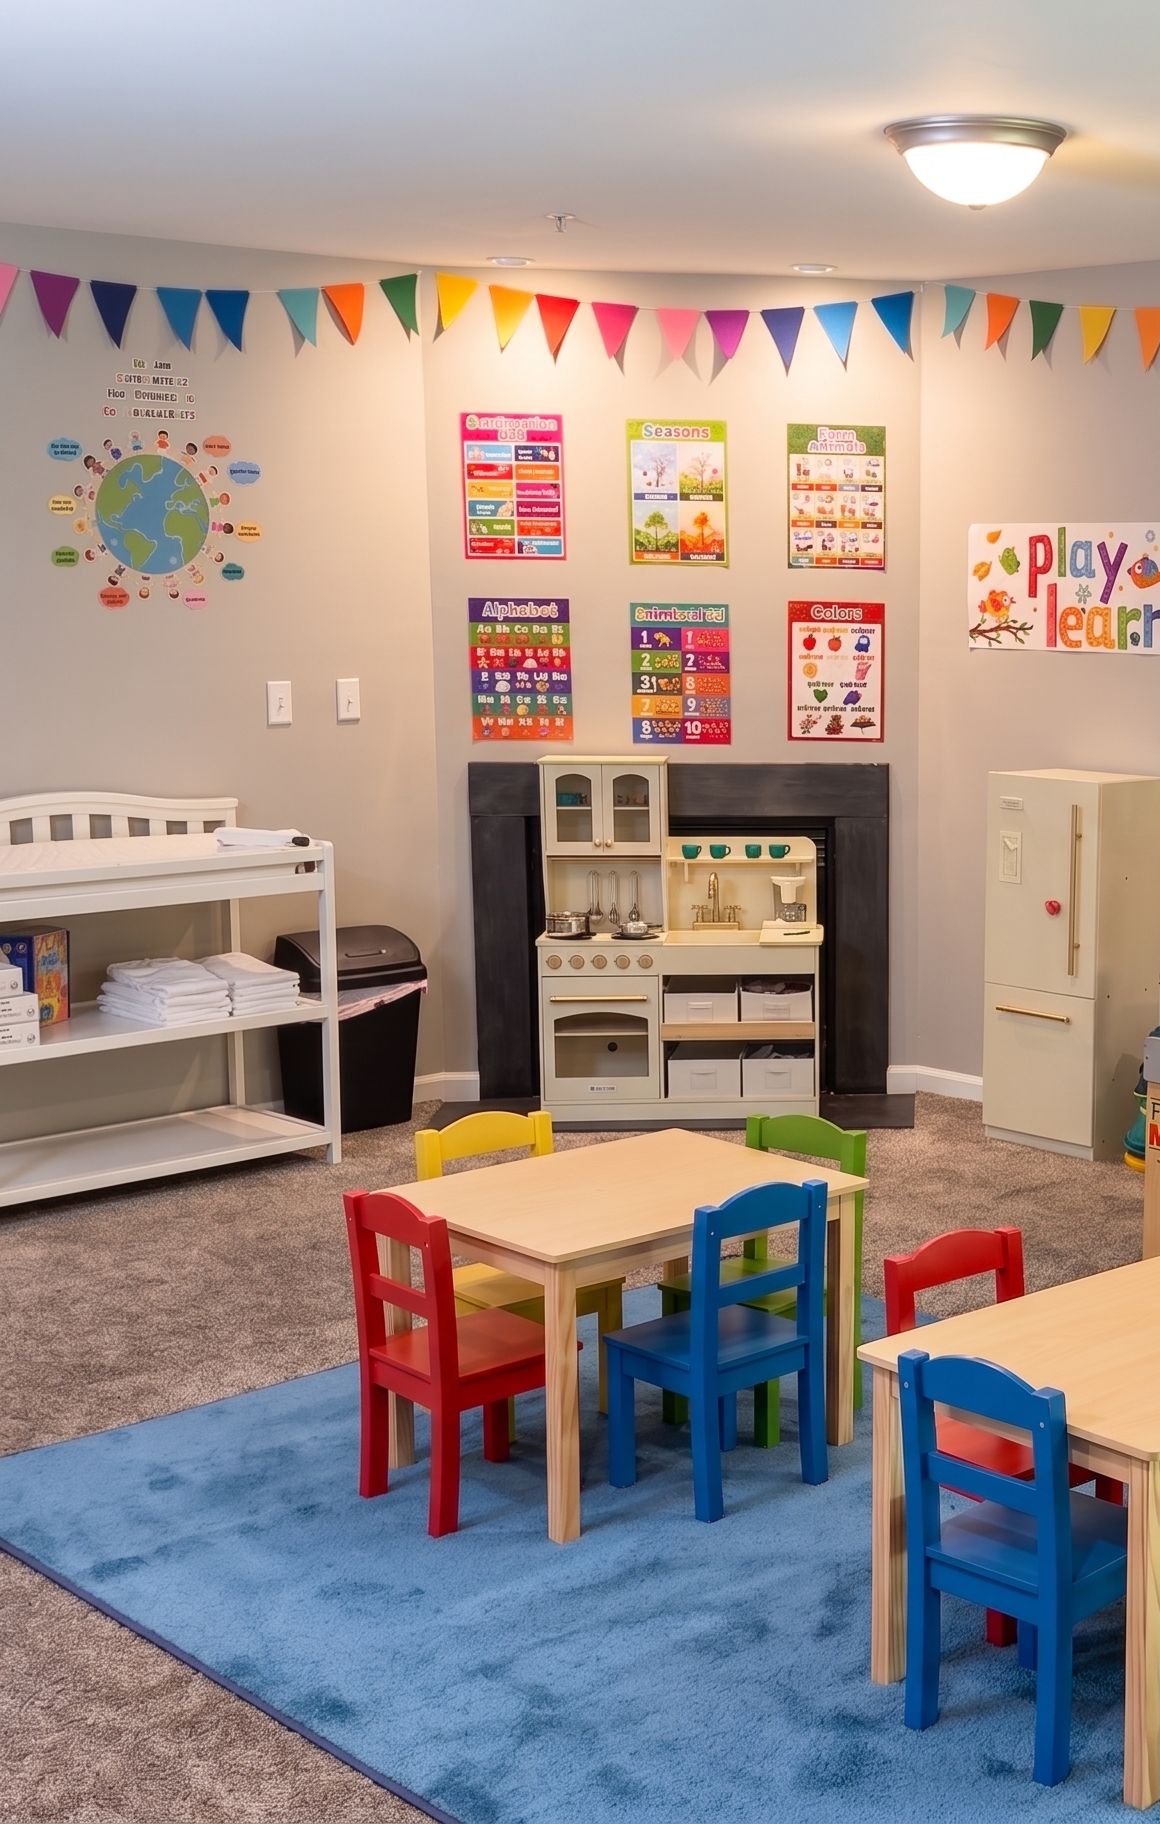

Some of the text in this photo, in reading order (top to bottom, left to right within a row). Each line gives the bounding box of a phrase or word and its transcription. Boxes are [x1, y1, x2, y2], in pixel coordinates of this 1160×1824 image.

[643, 424, 710, 438] Seasons
[1028, 526, 1128, 604] play
[811, 605, 862, 620] Colors
[640, 630, 648, 643] 1
[686, 631, 693, 644] 1
[641, 653, 650, 666] 2
[686, 654, 695, 667] 2
[641, 675, 650, 689] 3
[686, 677, 696, 689] 8
[641, 699, 650, 711] 7
[687, 698, 696, 711] 9
[642, 721, 651, 734] 8
[685, 721, 701, 734] 10
